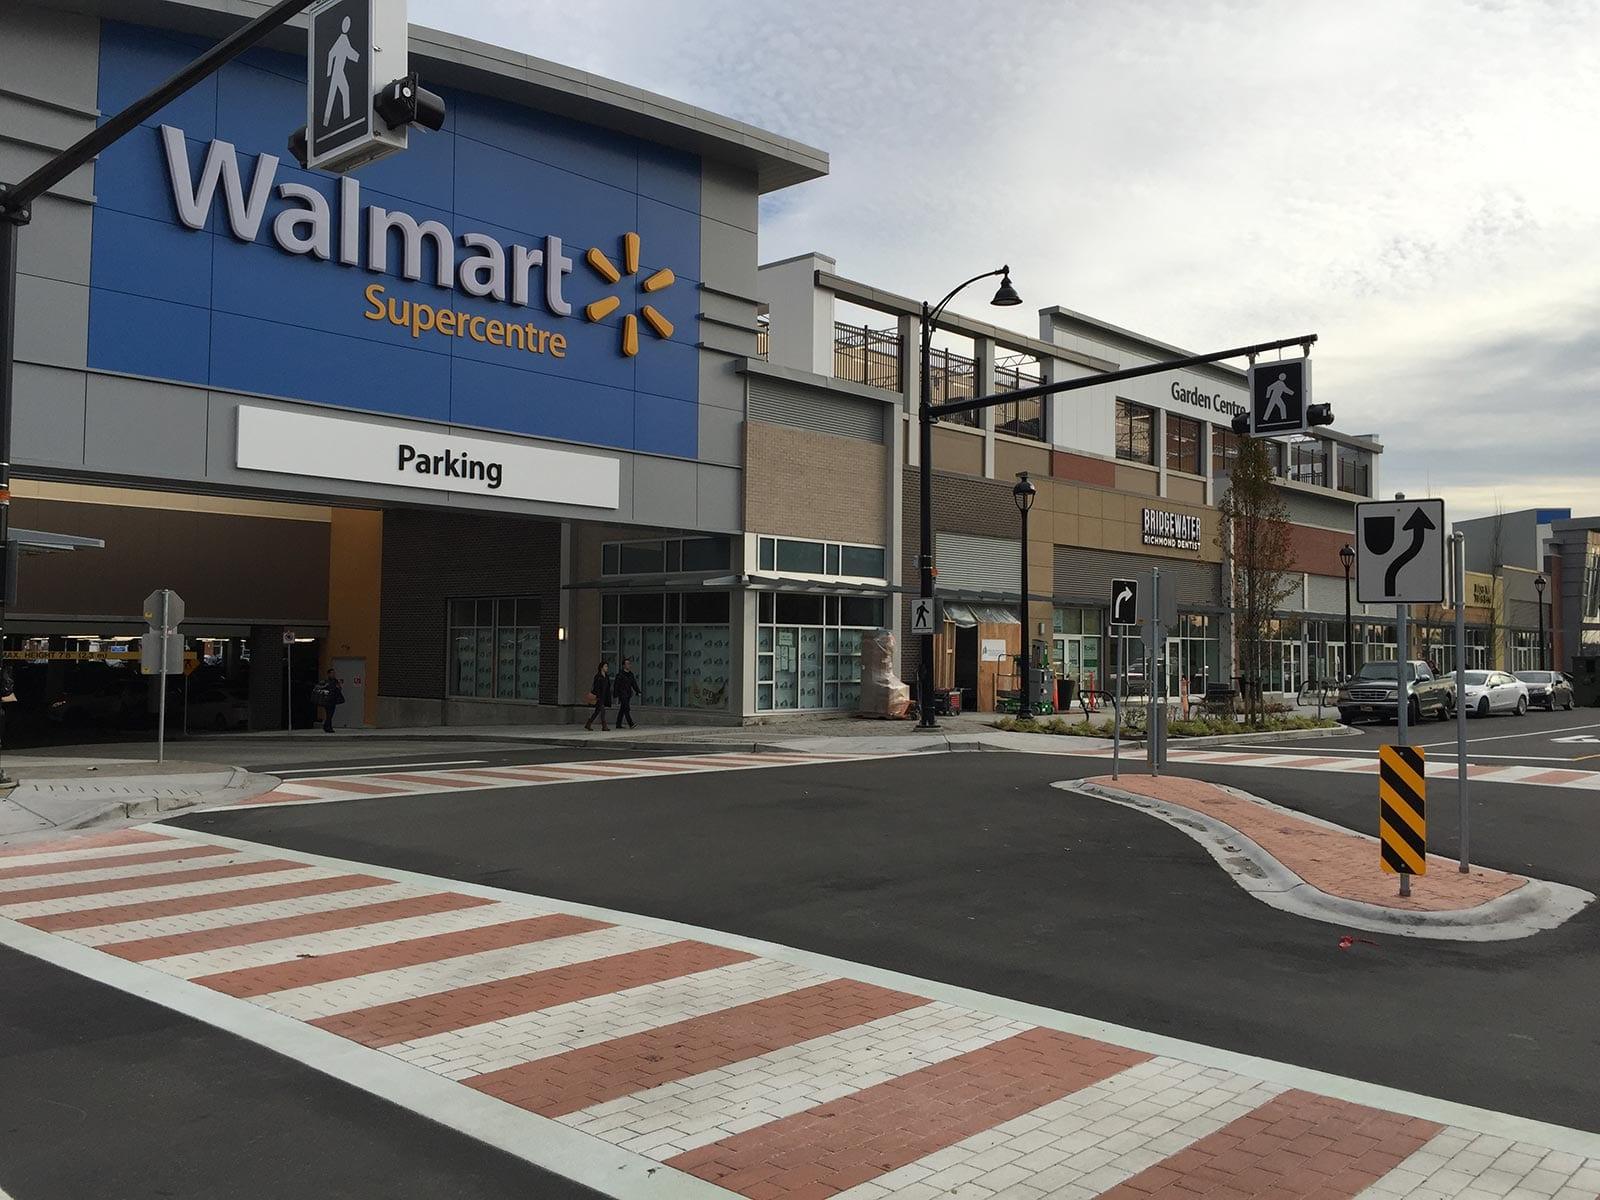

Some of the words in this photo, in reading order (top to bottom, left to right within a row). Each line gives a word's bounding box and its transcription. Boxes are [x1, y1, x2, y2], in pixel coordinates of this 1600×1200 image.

[160, 124, 573, 316] Walmart
[364, 283, 568, 359] Supercentre
[1171, 381, 1211, 410] Garden
[398, 444, 503, 489] Parking
[1143, 508, 1201, 541] BRIDGEWATER
[1144, 535, 1177, 548] RICHMOND
[1177, 539, 1201, 551] DENTIST
[24, 651, 56, 660] HEIGHT
